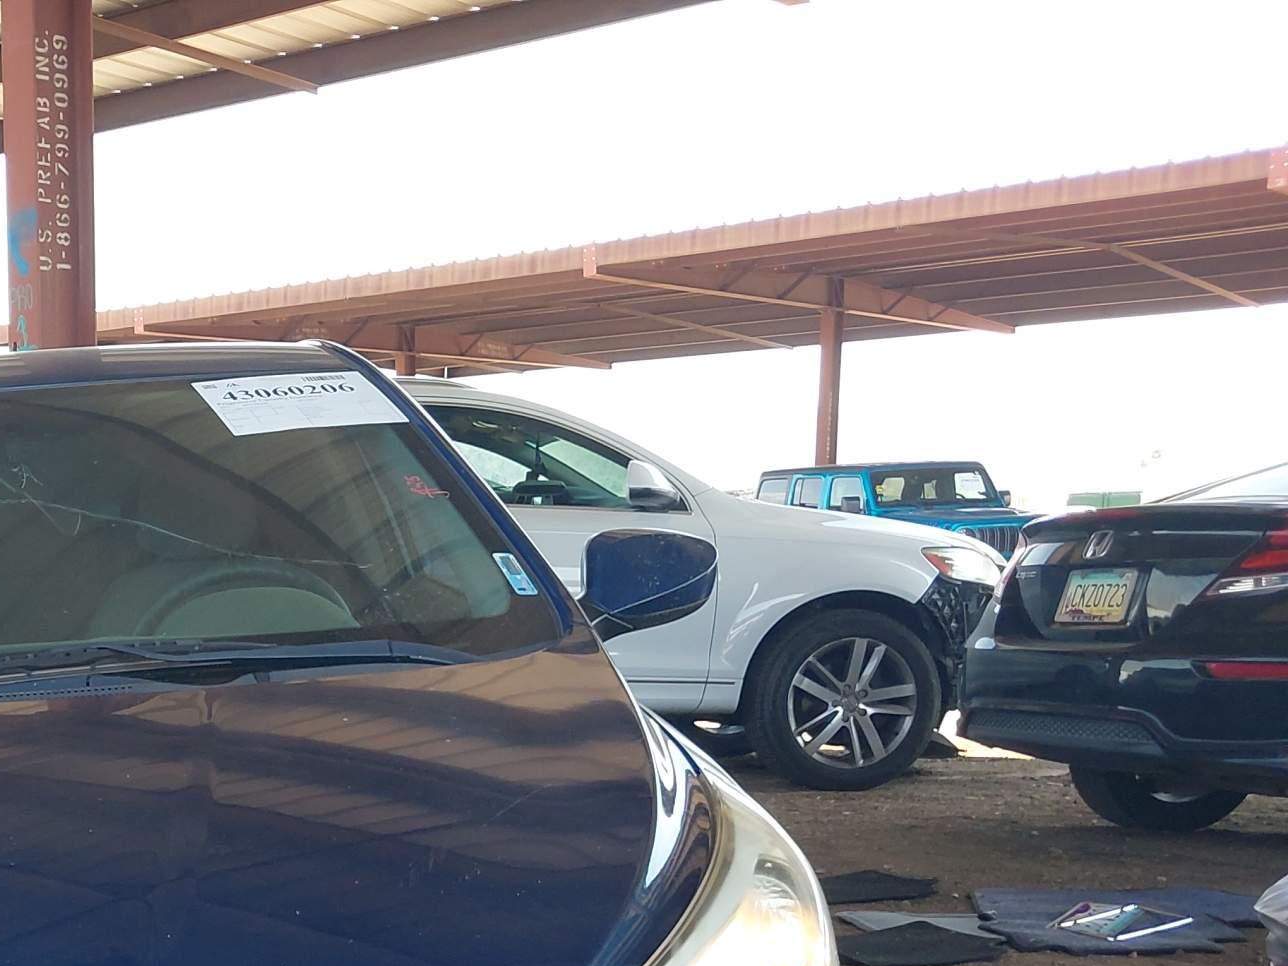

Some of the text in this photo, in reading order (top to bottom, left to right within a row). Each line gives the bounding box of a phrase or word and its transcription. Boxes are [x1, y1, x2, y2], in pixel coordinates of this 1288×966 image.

[34, 29, 53, 271] U.S. PREFAB INC.
[53, 34, 72, 271] 1-866-799-0969
[221, 381, 355, 402] 43060206
[1070, 583, 1128, 608] CKZ0723
